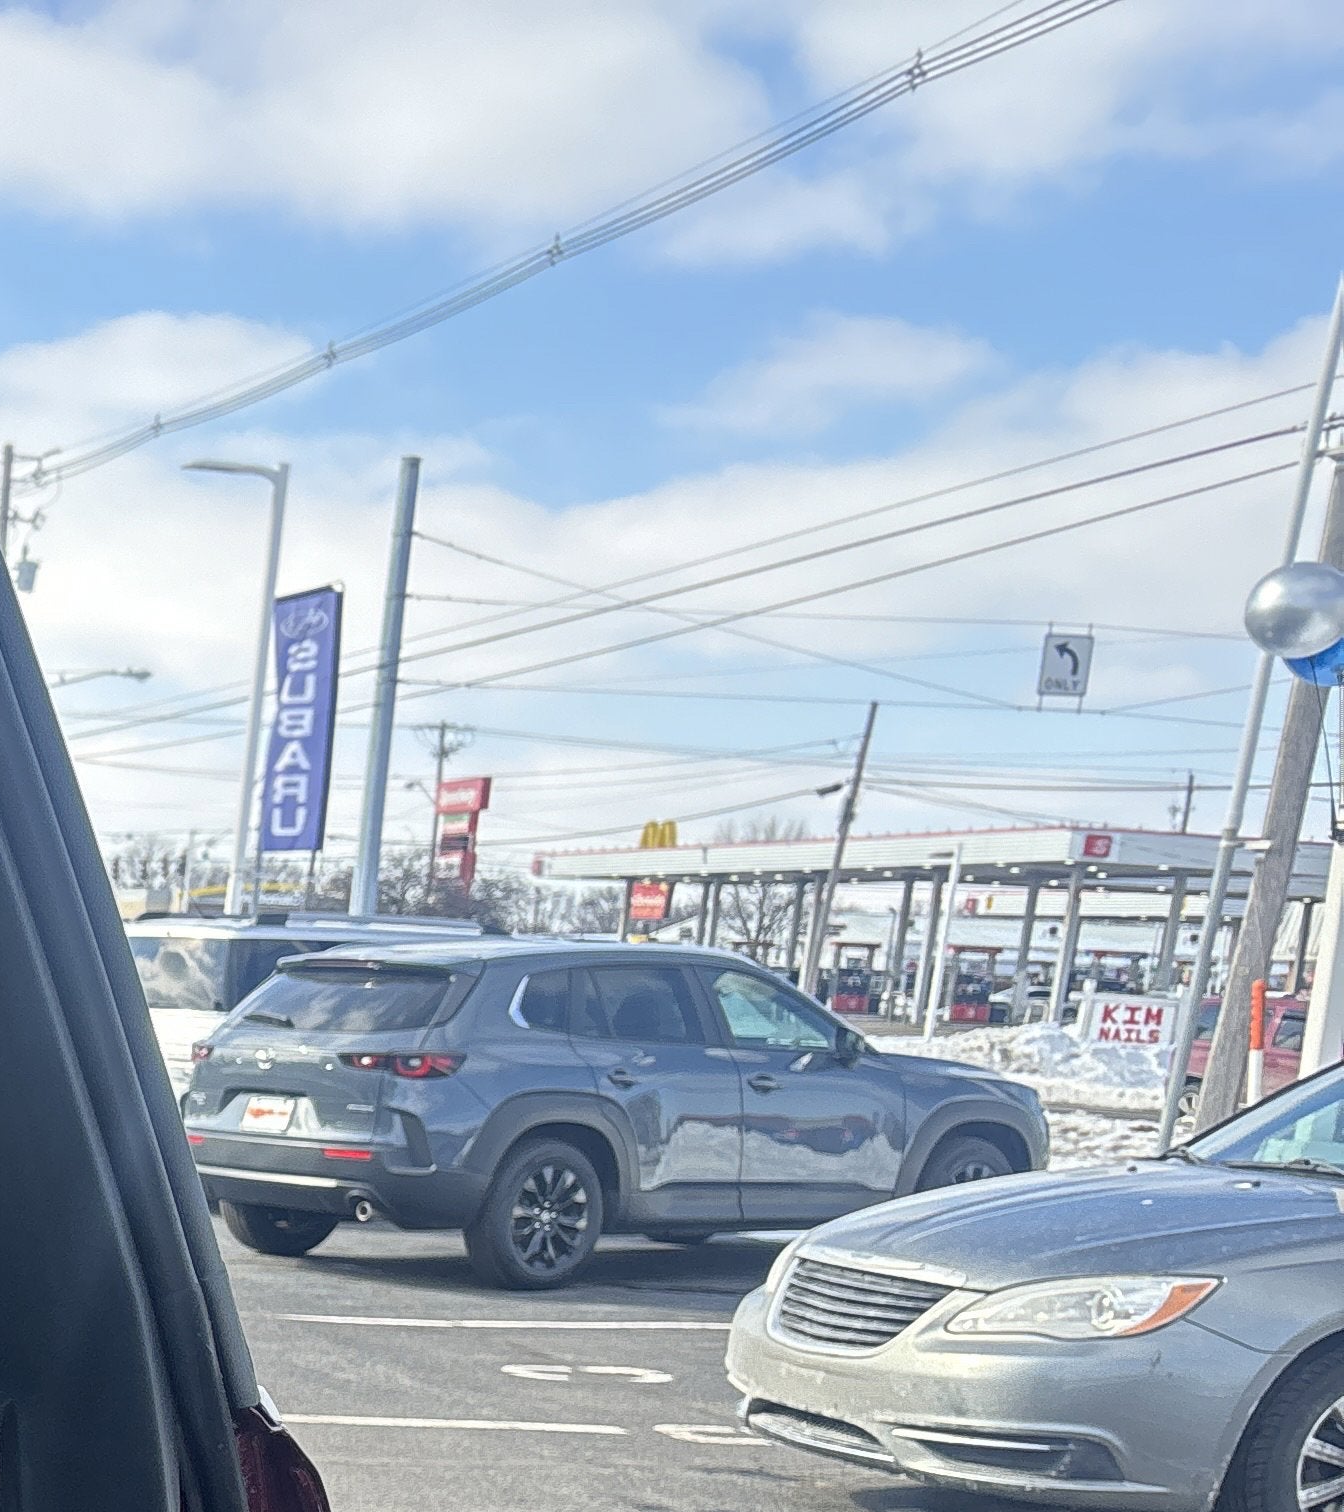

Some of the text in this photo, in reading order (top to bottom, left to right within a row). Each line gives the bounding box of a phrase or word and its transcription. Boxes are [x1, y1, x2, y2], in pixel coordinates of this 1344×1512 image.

[1044, 677, 1081, 692] ONLY
[1101, 1002, 1164, 1027] KIM
[1098, 1026, 1161, 1044] NAILS
